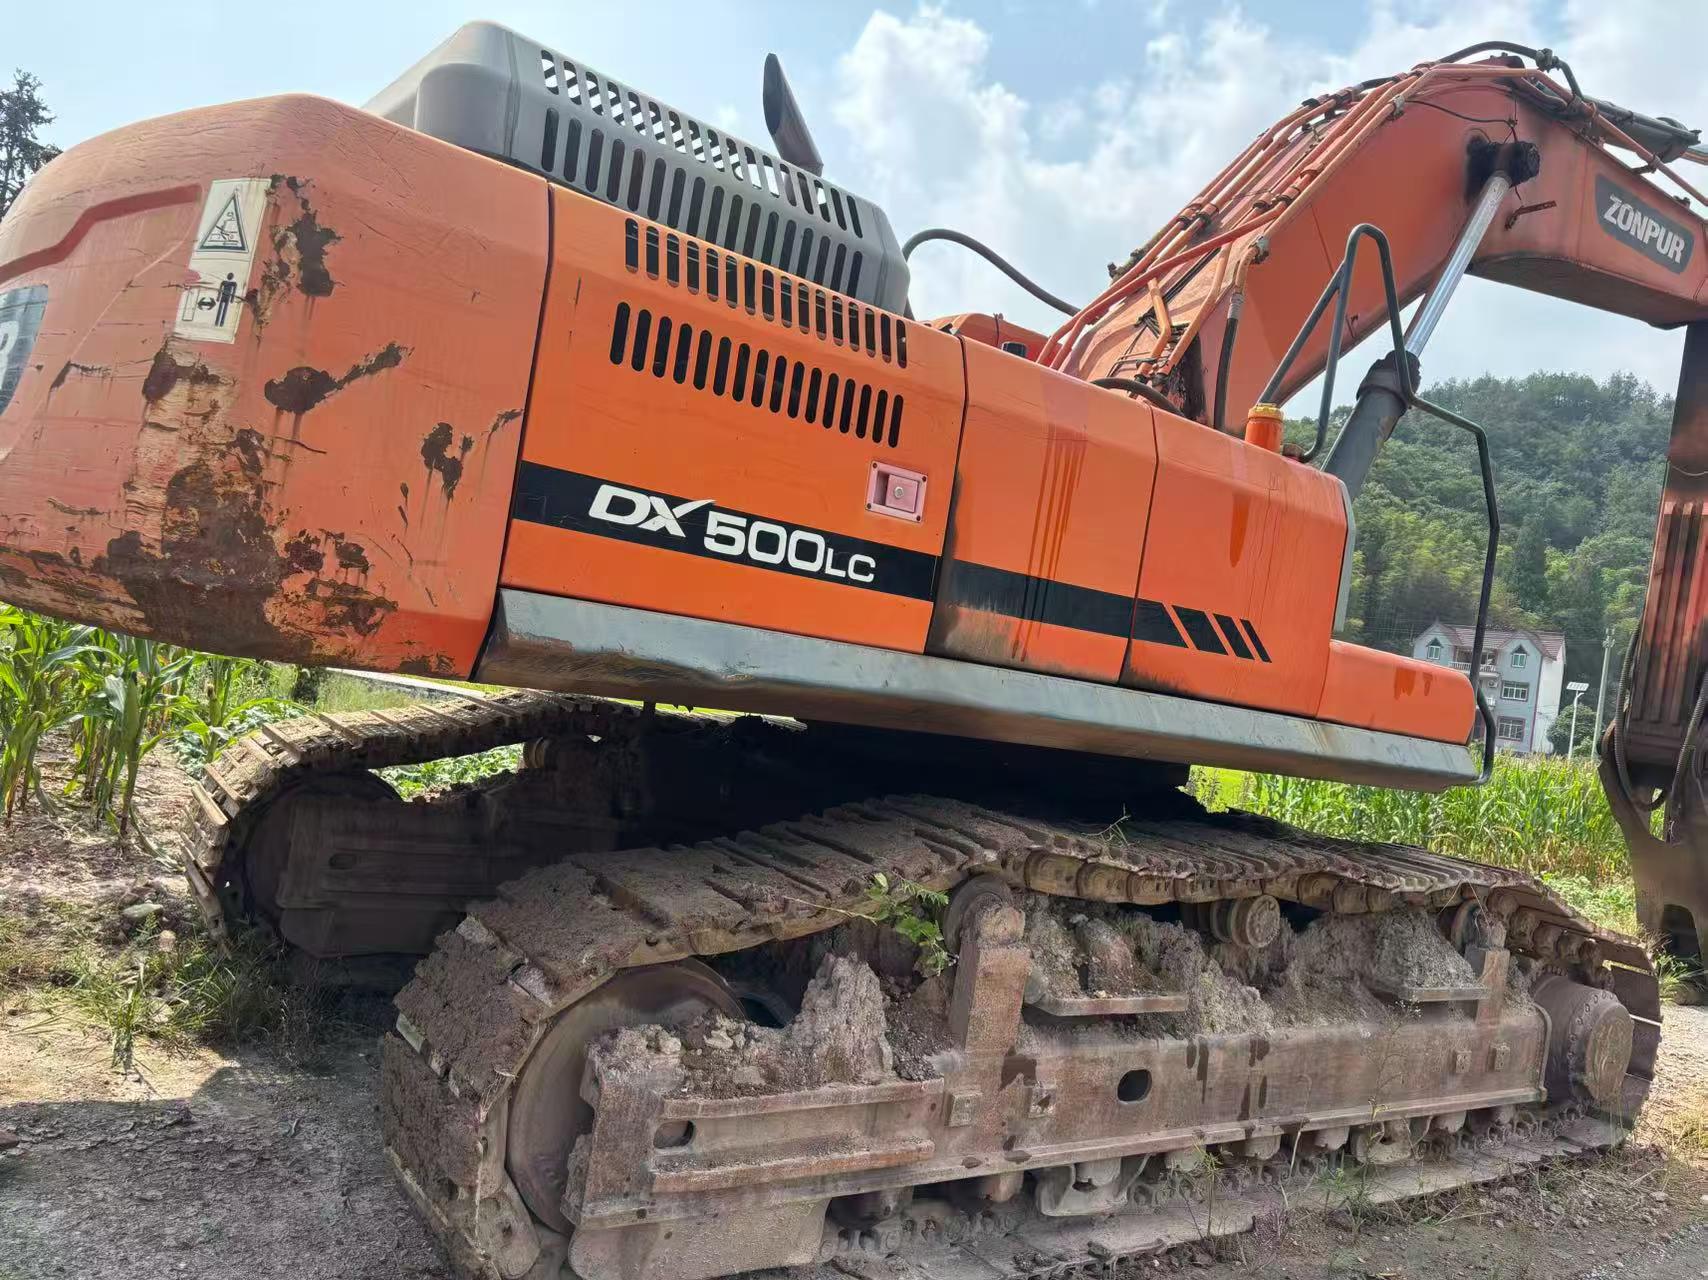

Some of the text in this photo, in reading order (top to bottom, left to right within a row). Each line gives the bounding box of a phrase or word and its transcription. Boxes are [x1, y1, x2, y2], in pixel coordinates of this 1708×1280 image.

[1604, 194, 1685, 263] ZONPUR
[588, 484, 876, 583] DX 500LC
